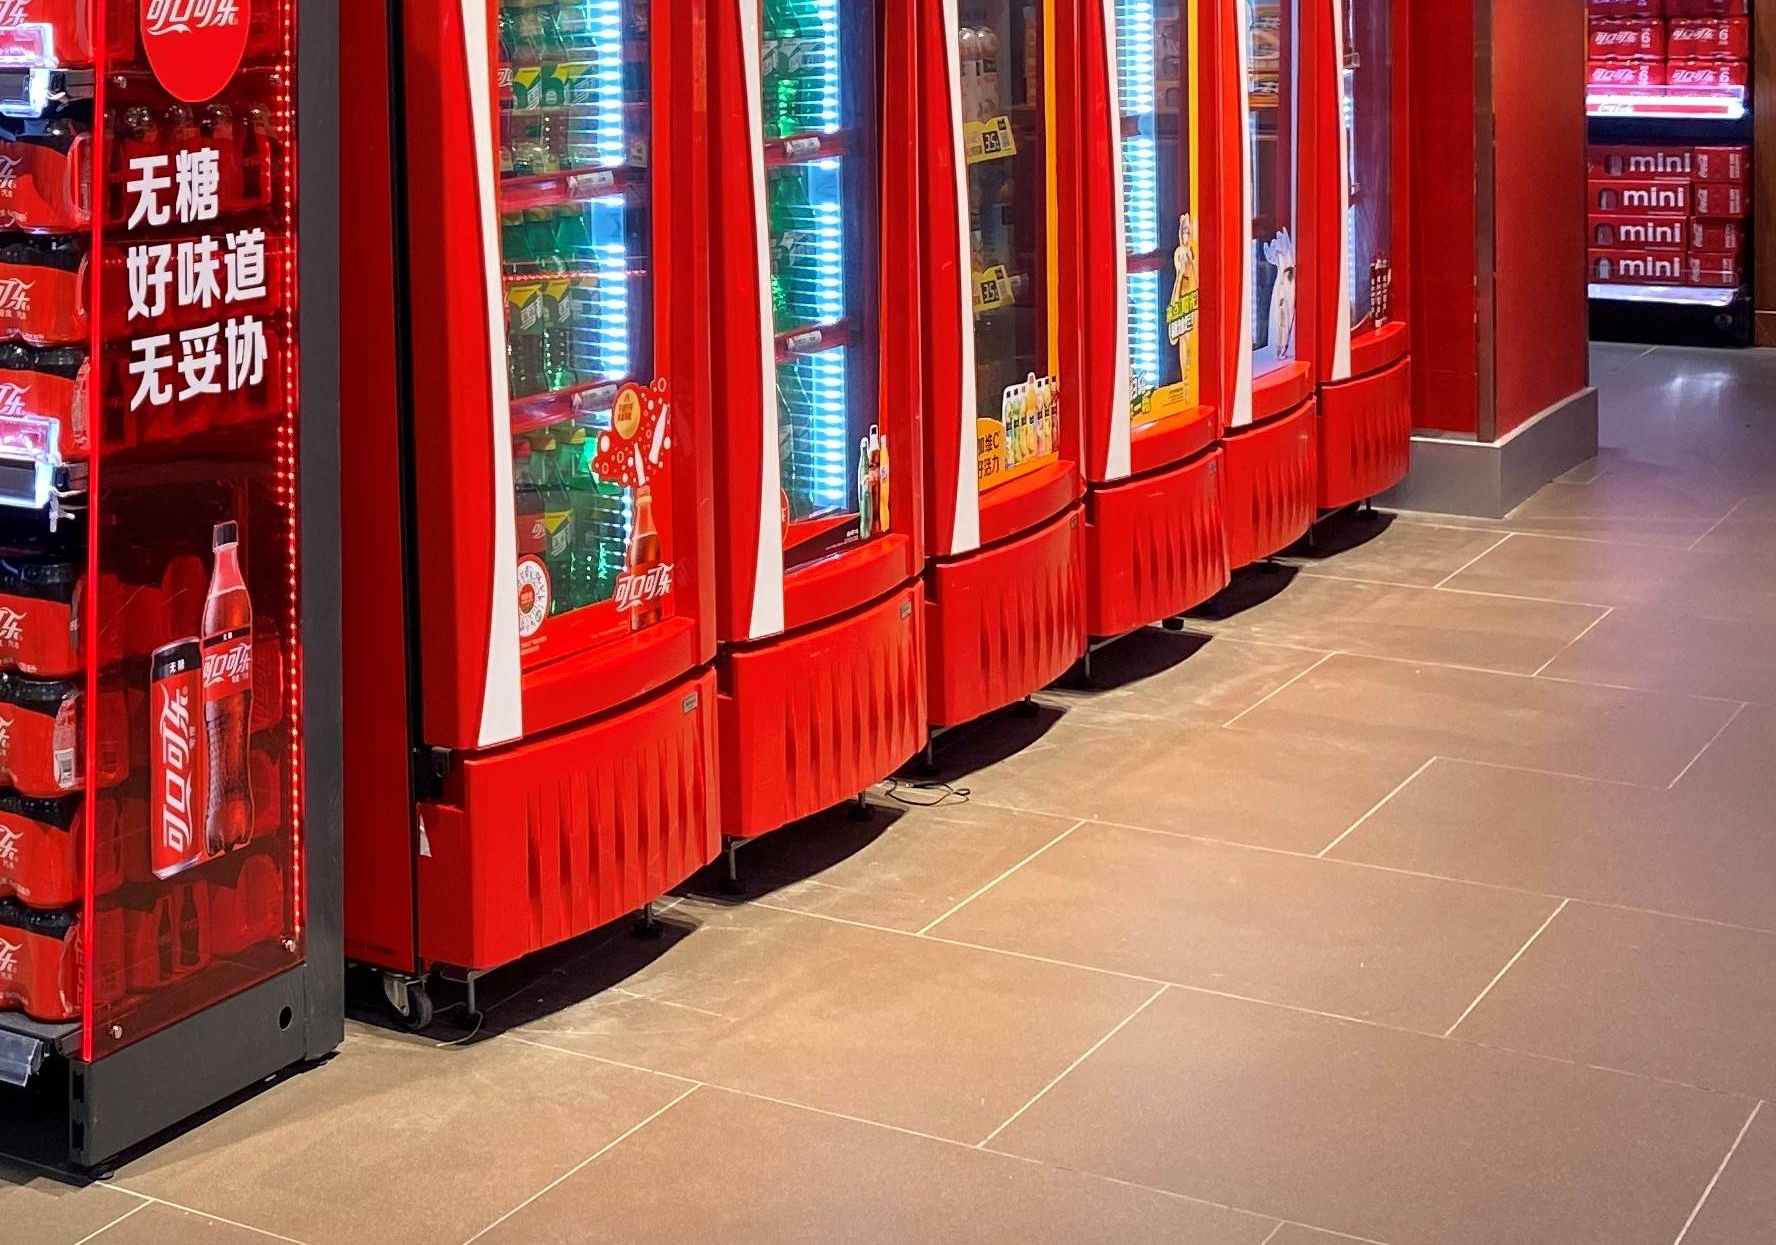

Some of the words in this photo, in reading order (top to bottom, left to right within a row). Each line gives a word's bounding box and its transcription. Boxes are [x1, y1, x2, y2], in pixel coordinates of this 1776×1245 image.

[1630, 152, 1691, 173] mini
[127, 147, 219, 230] 无糖
[1623, 186, 1684, 208] mini
[1620, 221, 1681, 243] mini
[127, 228, 266, 322] 好味道
[1619, 256, 1681, 278] mini
[128, 315, 267, 411] 无妥协
[614, 563, 674, 612] 可口可乐
[169, 659, 185, 674] 无糖
[204, 643, 252, 687] 可口可乐
[160, 683, 192, 853] 可口可乐
